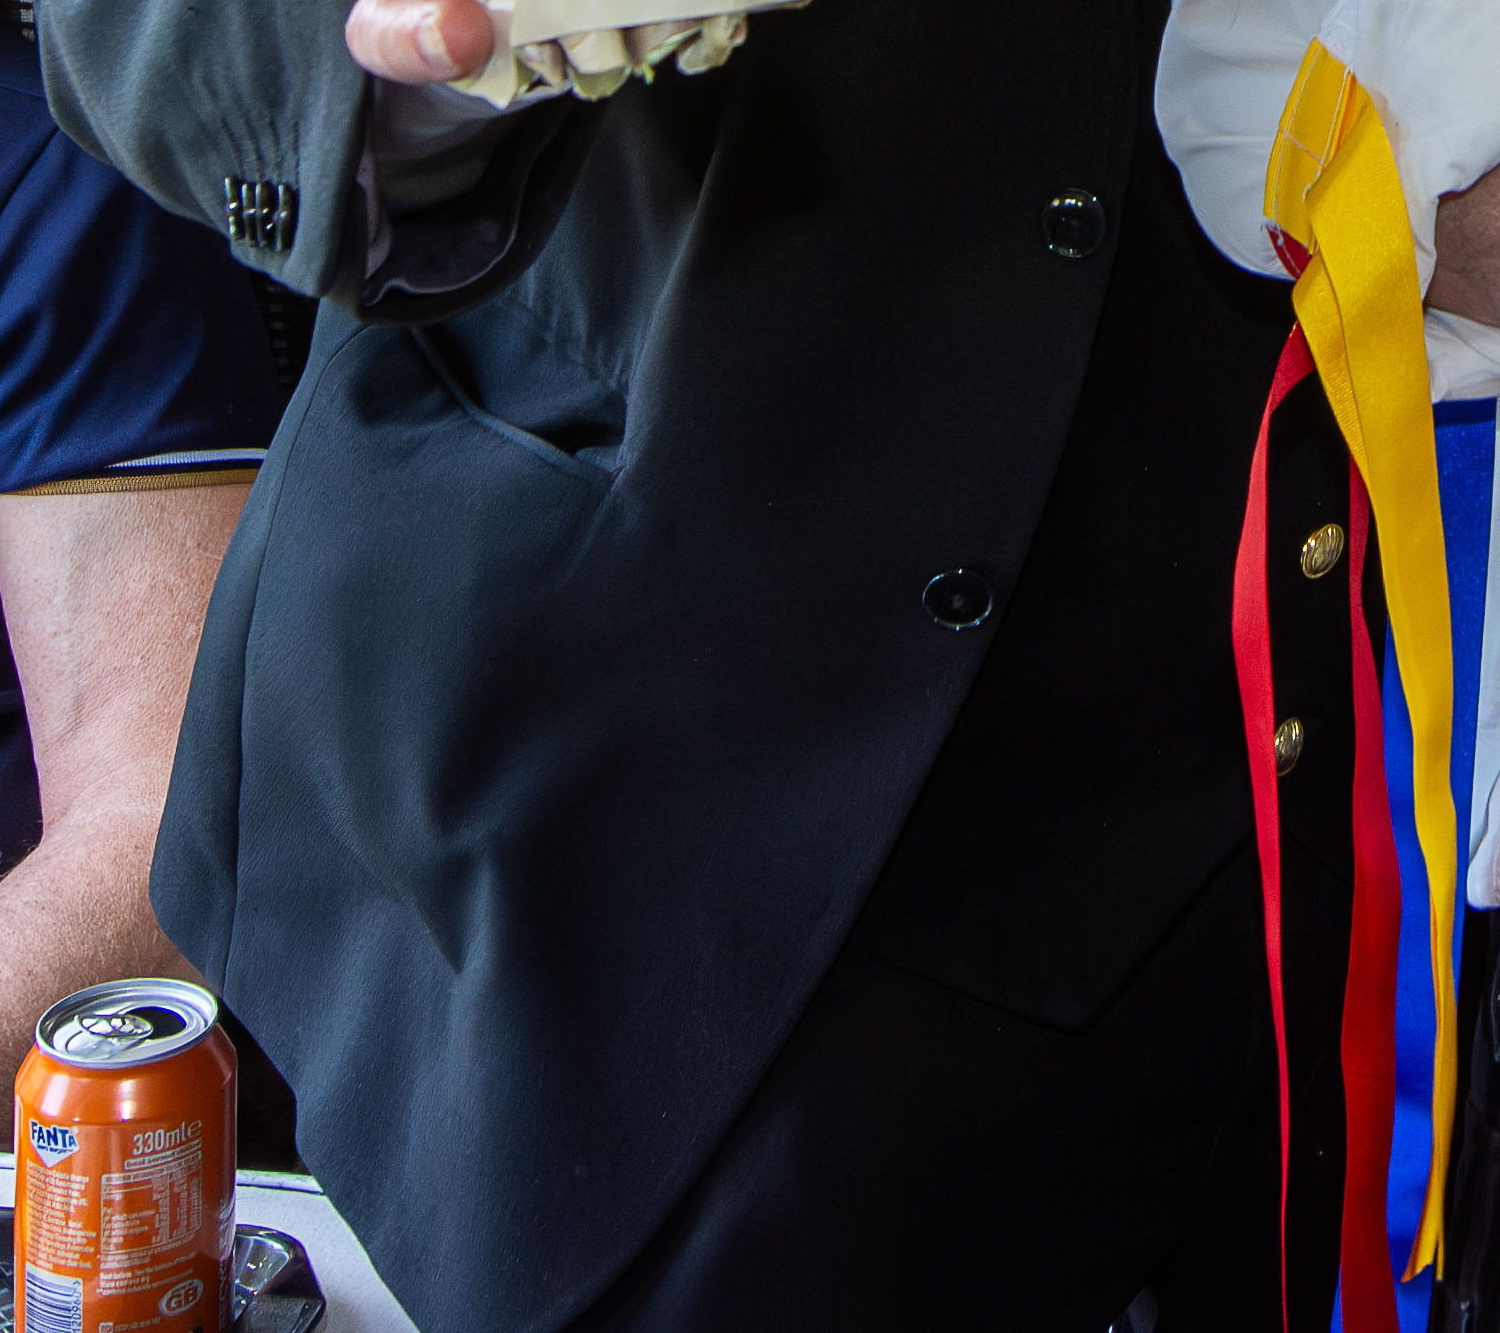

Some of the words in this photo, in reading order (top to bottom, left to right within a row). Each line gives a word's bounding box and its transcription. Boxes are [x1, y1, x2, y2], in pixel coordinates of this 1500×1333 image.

[30, 1120, 78, 1149] FANTA
[132, 1120, 187, 1156] 330ml
[165, 1283, 199, 1310] GB
